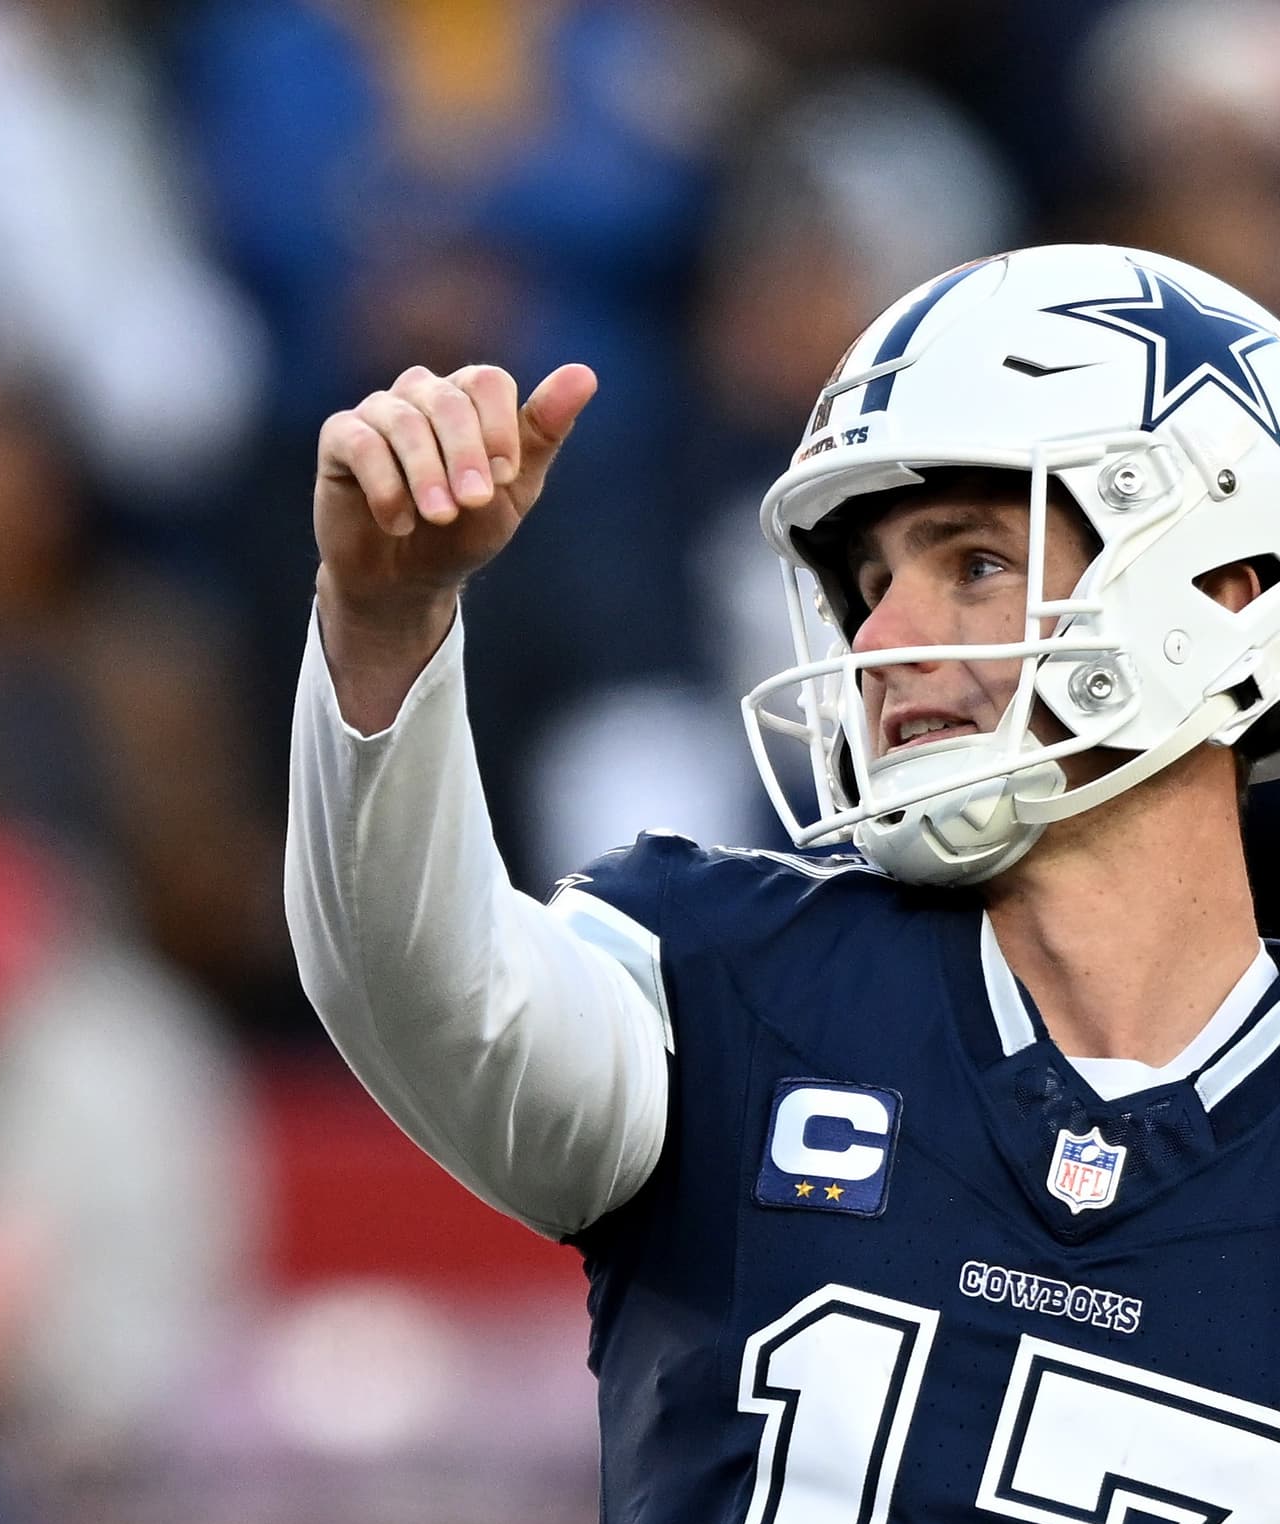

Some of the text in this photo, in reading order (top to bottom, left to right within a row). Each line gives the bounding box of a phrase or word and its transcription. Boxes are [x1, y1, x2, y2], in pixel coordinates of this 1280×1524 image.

[771, 1087, 889, 1181] C
[1059, 1162, 1105, 1198] NFL
[959, 1260, 1143, 1334] COWBOYS
